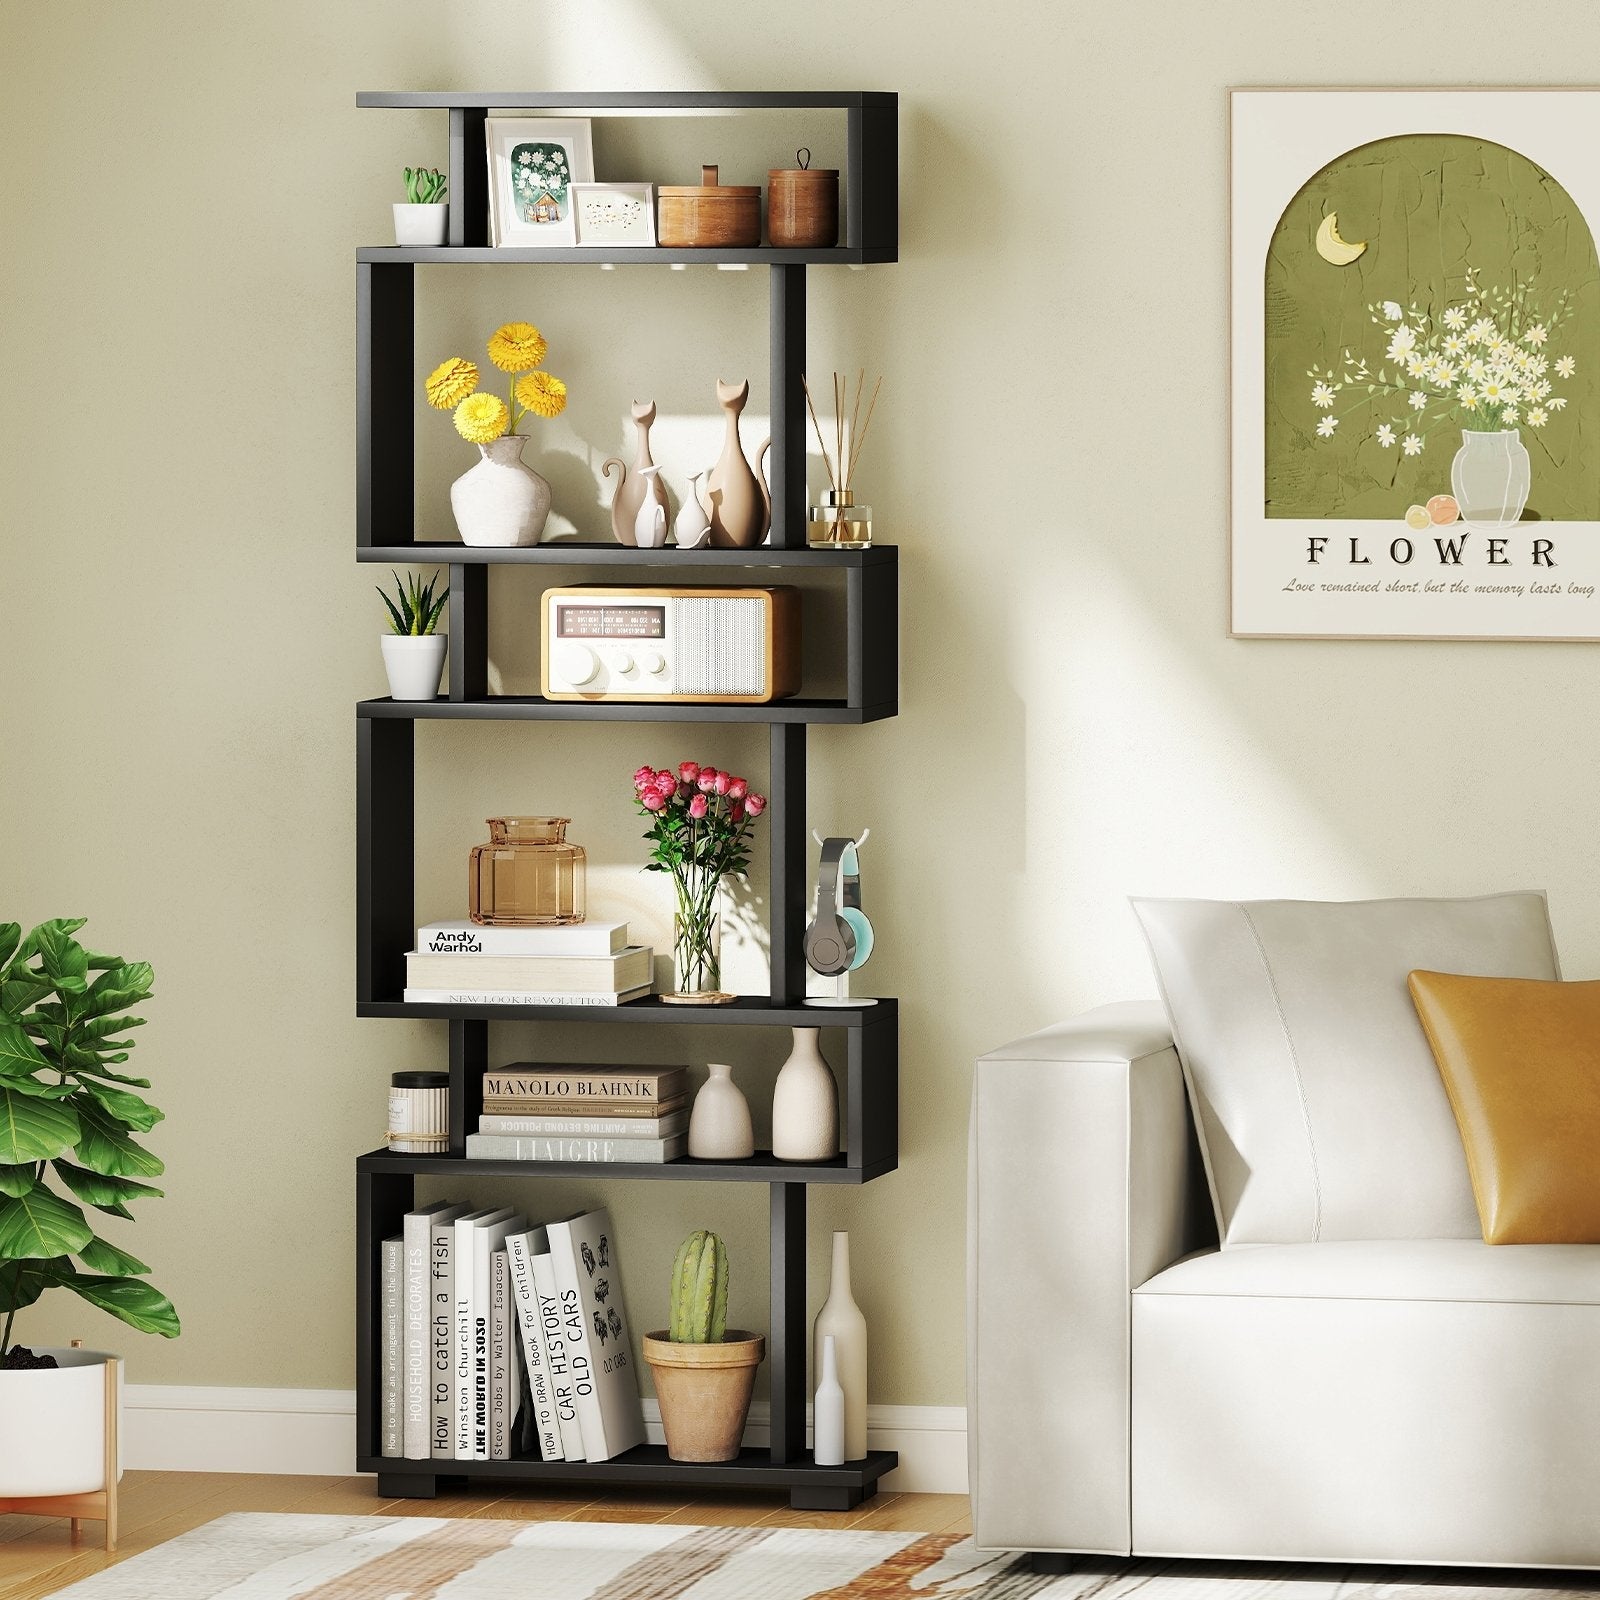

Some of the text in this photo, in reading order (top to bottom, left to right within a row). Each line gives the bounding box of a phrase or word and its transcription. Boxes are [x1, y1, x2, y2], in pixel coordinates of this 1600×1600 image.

[1307, 532, 1559, 569] FLOWER
[1282, 577, 1316, 593] Love
[1320, 580, 1382, 594] remained
[1449, 580, 1469, 594] the
[1474, 583, 1526, 598] memory
[1529, 581, 1562, 595] lasts
[1567, 581, 1595, 599] long
[429, 942, 482, 953] Warhol
[435, 932, 476, 944] Andy
[449, 995, 610, 1006] NEW LOOK REVOLUTION
[487, 1079, 653, 1097] MANOLO BLAHNÍK
[500, 1121, 541, 1131] POLLOCK
[542, 1121, 581, 1132] BEYOND
[584, 1122, 627, 1134] PAINTING
[516, 1139, 616, 1162] LIAIGRE
[388, 1246, 396, 1450] How to make an arrangement in the house
[409, 1248, 422, 1422] HOUSEHOLD DECORATES
[433, 1236, 448, 1450] How to catch a fish
[513, 1240, 556, 1455] HOW TO DRAW Book for children
[561, 1289, 592, 1396] OLD CARS
[493, 1254, 505, 1456] Steve Jobs by Walter Isaacson
[540, 1295, 575, 1421] CAR HISTORY
[457, 1298, 469, 1450] Winston Churchill
